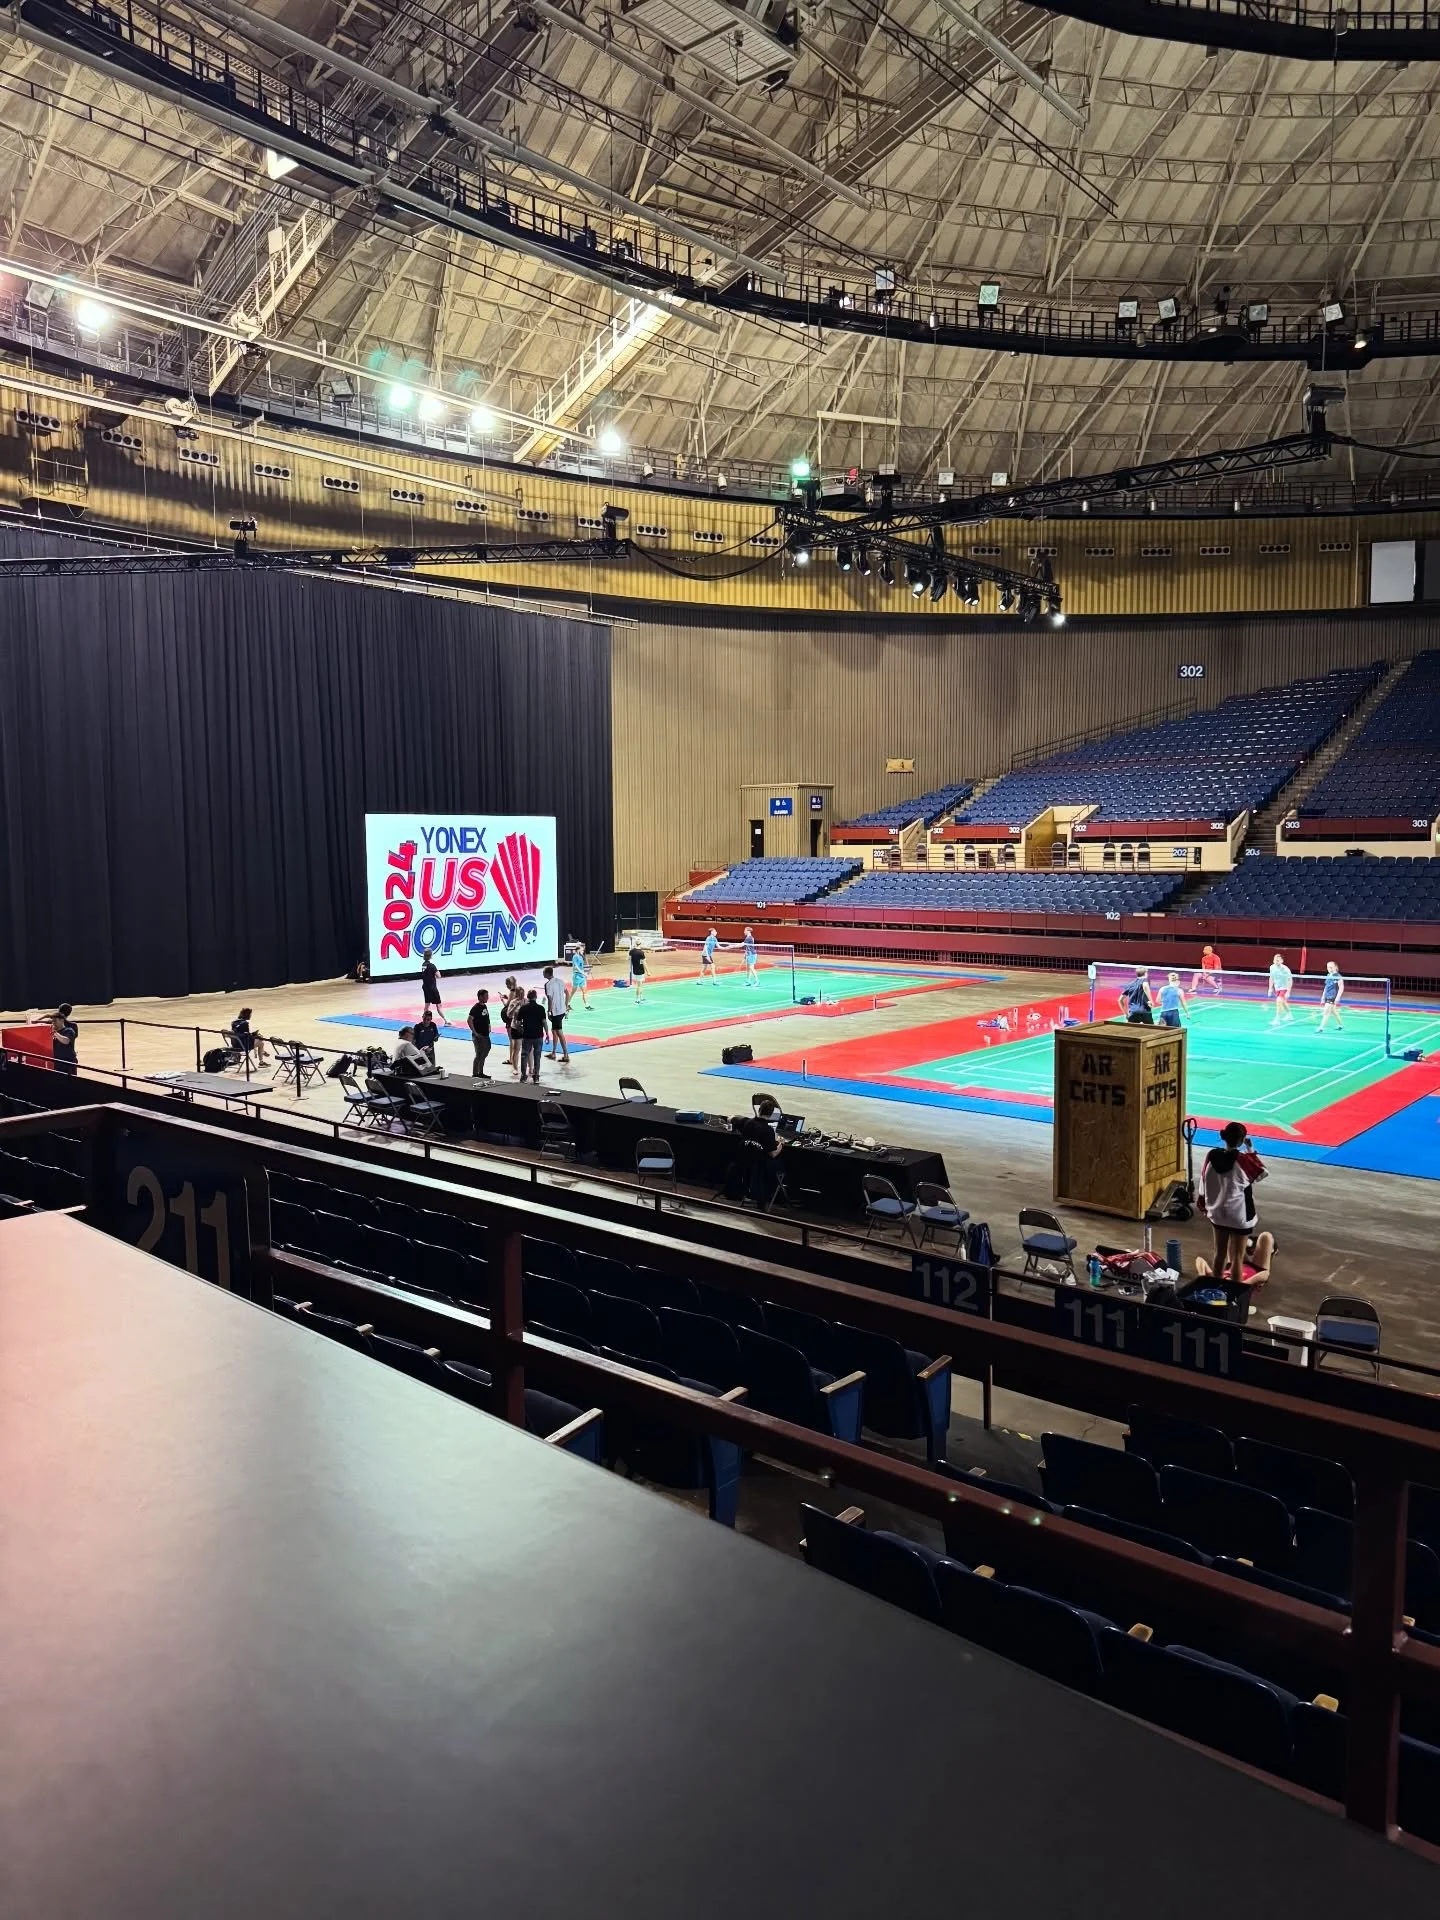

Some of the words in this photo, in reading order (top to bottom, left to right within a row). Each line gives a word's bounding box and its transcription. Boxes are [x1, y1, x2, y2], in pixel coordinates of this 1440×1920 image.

[1180, 665, 1203, 678] 302
[1008, 826, 1020, 834] 302
[1074, 824, 1087, 832] 302
[1210, 822, 1224, 830] 302
[1285, 821, 1300, 829] 303
[1412, 819, 1428, 828] 303
[420, 826, 487, 854] YONEX
[1172, 848, 1187, 857] 202
[419, 857, 490, 912] US
[380, 839, 418, 960] 2024
[1105, 912, 1121, 921] 102
[411, 911, 517, 957] OPEN
[1081, 1053, 1112, 1076] AR
[1153, 1051, 1170, 1076] AR
[1069, 1079, 1126, 1106] CRTS
[127, 1165, 231, 1291] 211
[914, 1260, 979, 1313] 112
[1063, 1297, 1126, 1350] 111
[1161, 1320, 1230, 1375] 111
